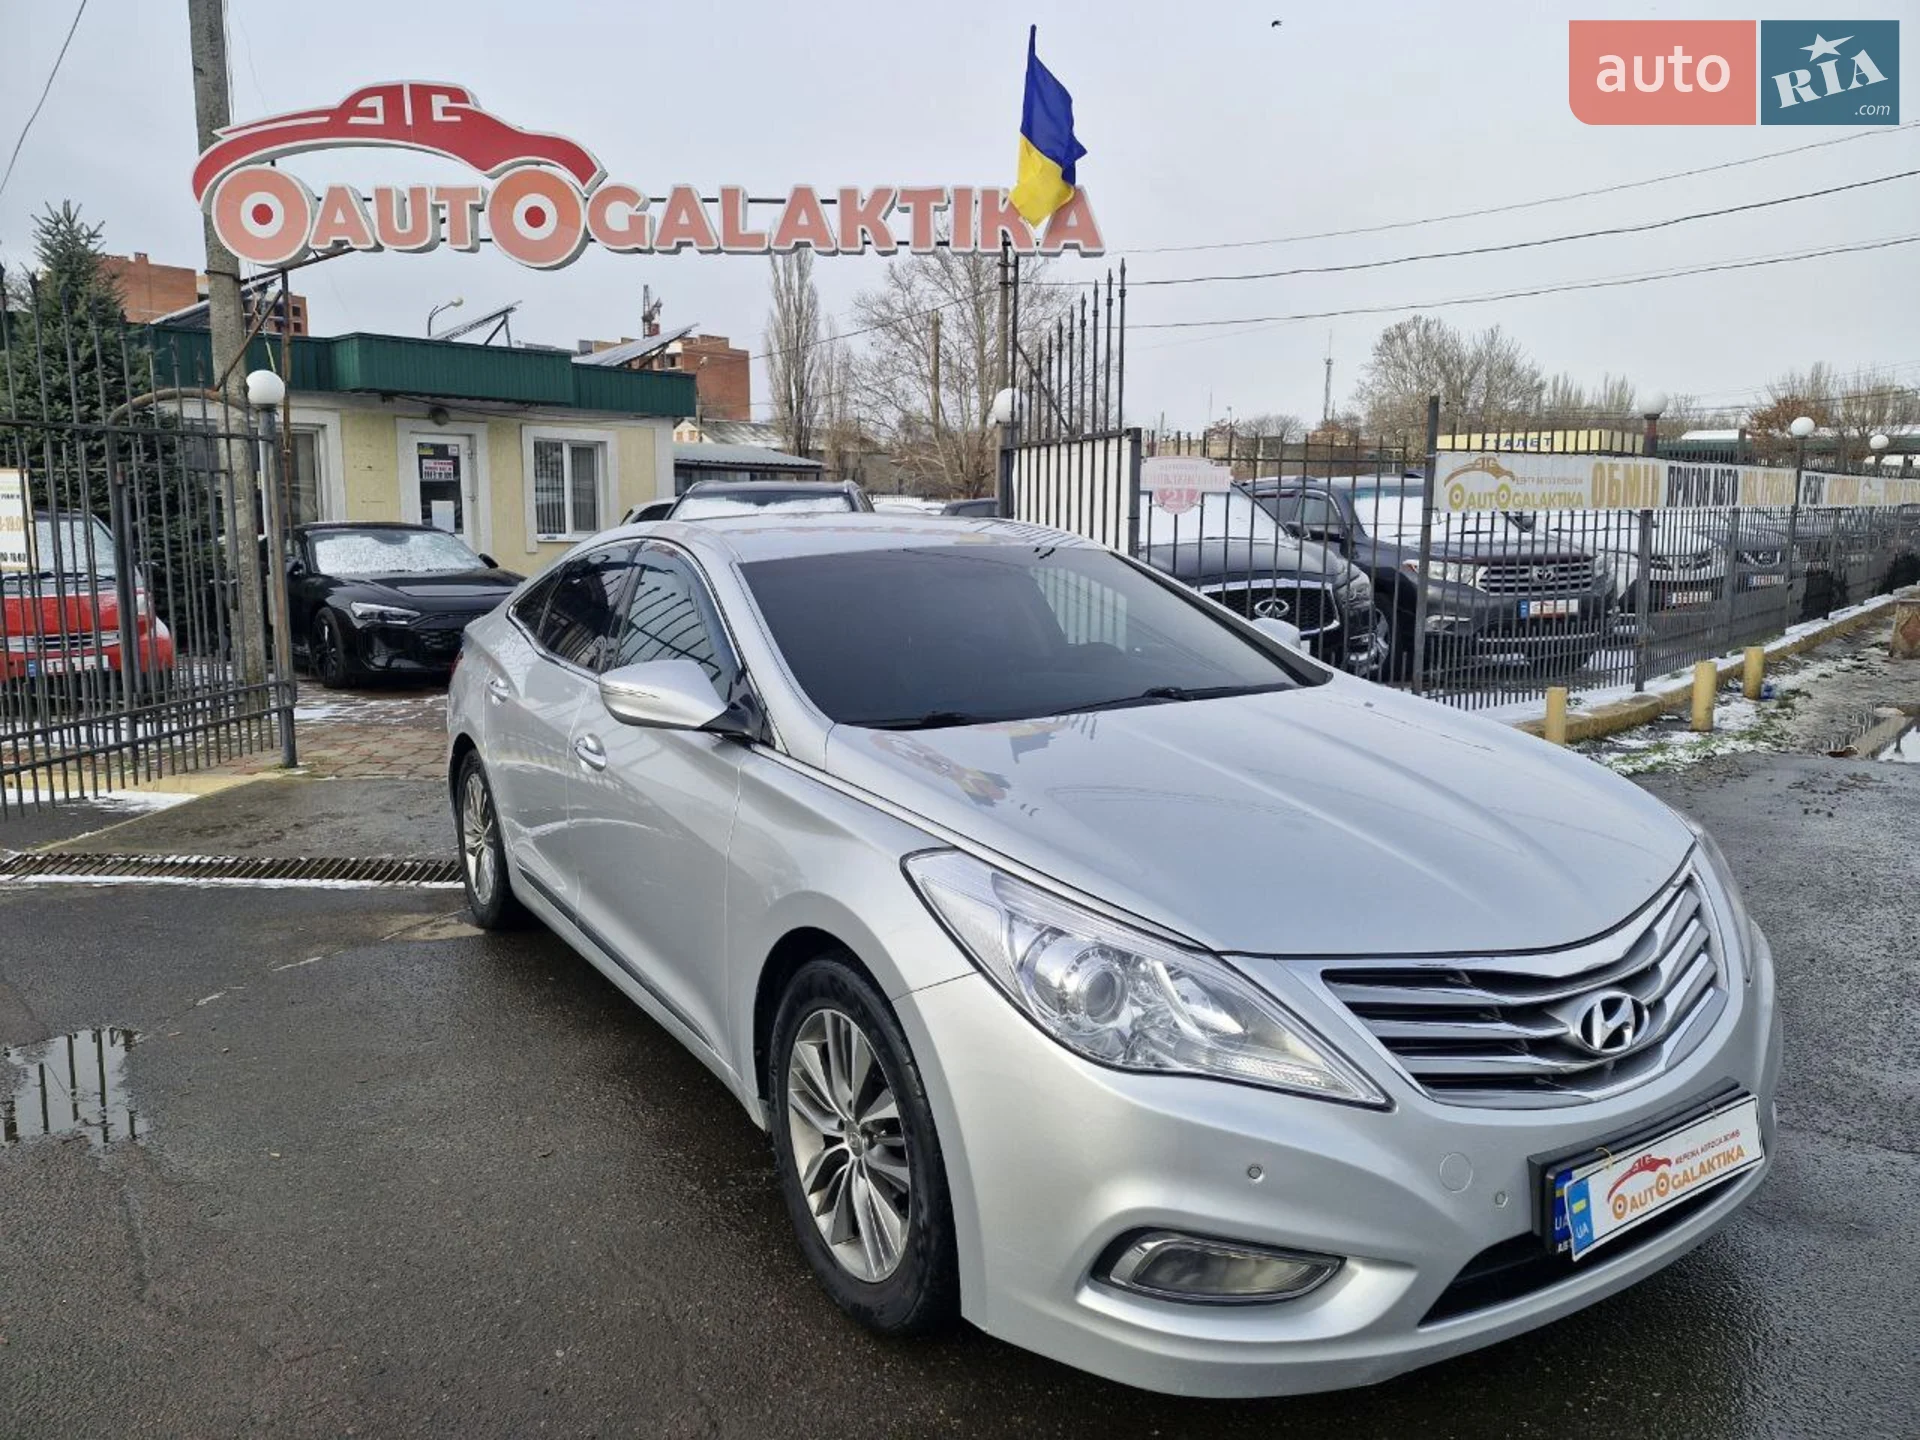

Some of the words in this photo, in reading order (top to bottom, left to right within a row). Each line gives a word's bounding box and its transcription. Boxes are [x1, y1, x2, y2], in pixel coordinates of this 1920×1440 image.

[1592, 463, 1660, 508] ОБМІН
[1666, 465, 1711, 507] ПРИГОН
[1712, 467, 1739, 506] АВТО
[1575, 1222, 1590, 1239] UA
